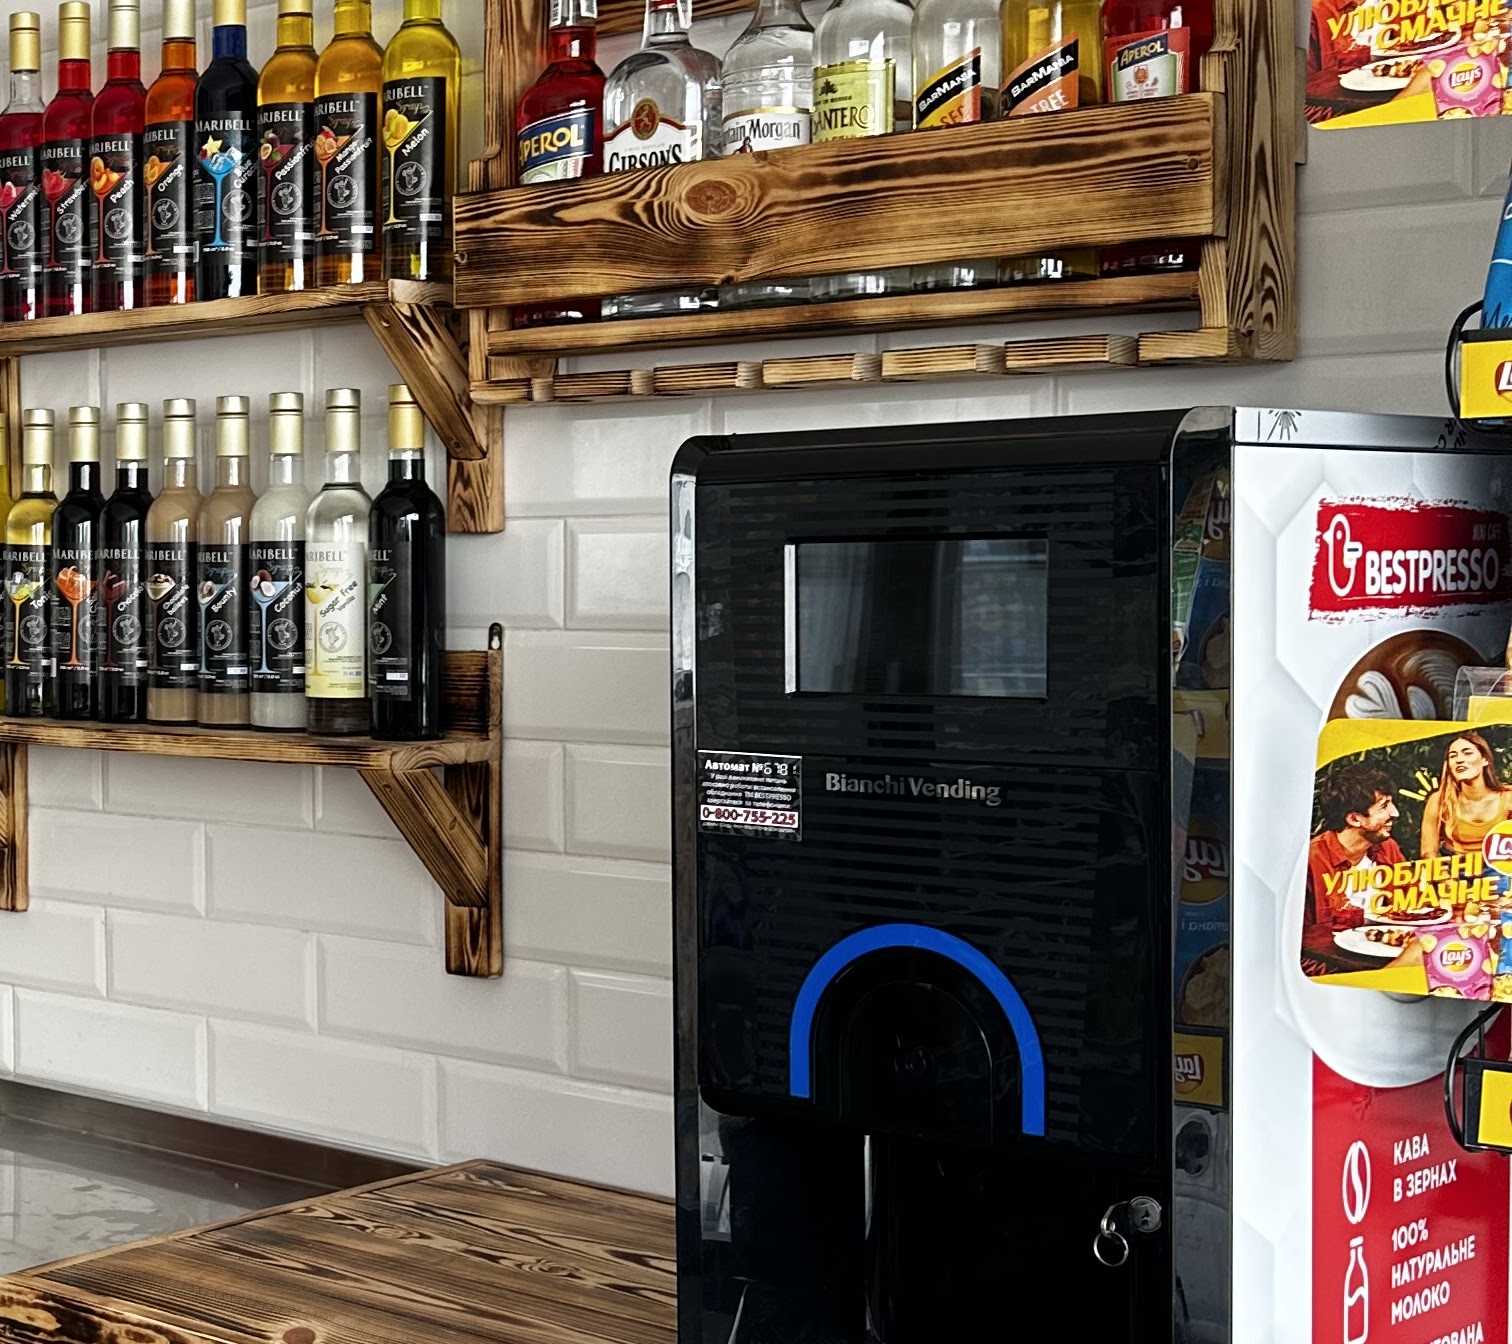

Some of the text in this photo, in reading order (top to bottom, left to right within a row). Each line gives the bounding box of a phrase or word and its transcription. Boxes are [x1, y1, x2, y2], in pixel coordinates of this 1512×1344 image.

[1121, 41, 1165, 66] APEROL
[402, 127, 430, 157] Melon
[520, 124, 584, 168] APEROL
[748, 118, 801, 141] Morgan
[110, 179, 135, 204] Peach
[158, 163, 185, 192] Orange
[1365, 547, 1499, 596] BESTPRESSO
[211, 586, 237, 613] Bounty
[274, 582, 304, 613] Coconut
[319, 580, 359, 618] Sugar free
[825, 772, 905, 795] Bianchi
[908, 777, 1002, 806] Vending
[1322, 853, 1483, 896] УЛЮБЛЕНІ
[1370, 876, 1501, 915] СМАЧНЕ
[1393, 1133, 1430, 1166] КАВА
[1393, 1158, 1458, 1202] В ЗЕРНАХ
[1391, 1217, 1429, 1252] 100%
[1391, 1235, 1476, 1288] НАТУРАЛЬНЕ
[1391, 1291, 1451, 1325] МОЛОКО
